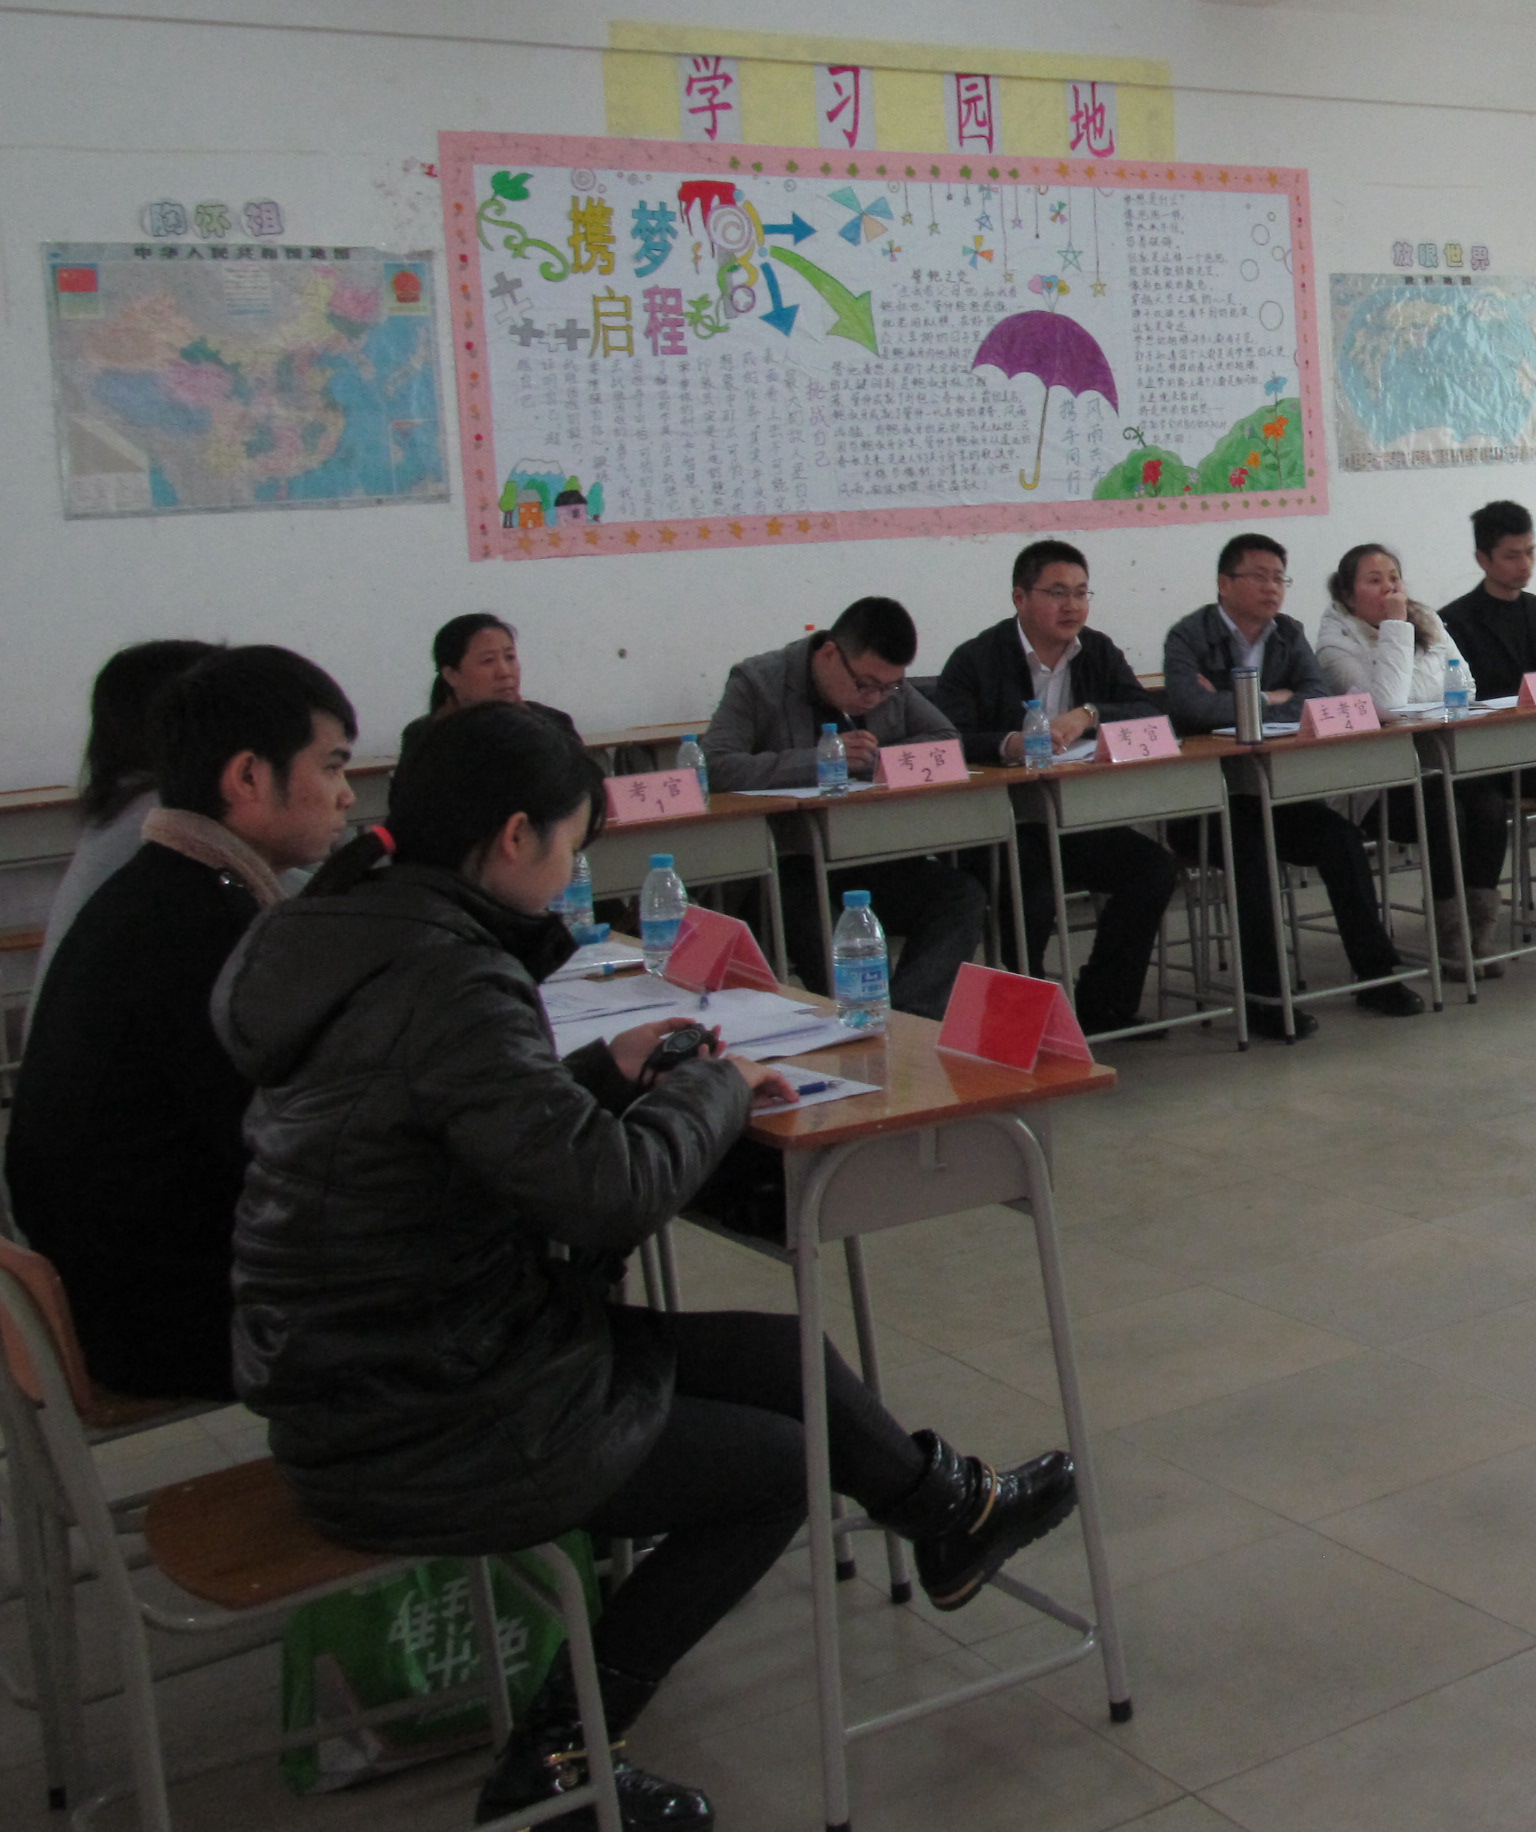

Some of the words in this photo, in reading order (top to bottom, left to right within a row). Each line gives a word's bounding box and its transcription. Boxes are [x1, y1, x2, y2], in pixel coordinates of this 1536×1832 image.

[685, 55, 1115, 158] 学习园地
[149, 201, 285, 239] 胸怀祖
[567, 195, 679, 278] 携梦
[133, 244, 351, 261] 中华人民共和国地图
[1392, 240, 1490, 271] 放眼世界
[589, 284, 689, 358] 启程
[783, 349, 809, 513] 人最大的敌人是自己
[805, 377, 832, 468] 挑战自己
[1059, 397, 1081, 495] 携手同行
[1319, 698, 1369, 722] 主考官
[1118, 723, 1158, 746] 考官
[1344, 720, 1354, 731] 4
[898, 747, 947, 771] 考官
[1139, 743, 1150, 757] 3
[920, 767, 933, 782] 2
[629, 776, 682, 803] 考官
[655, 798, 665, 813] 1
